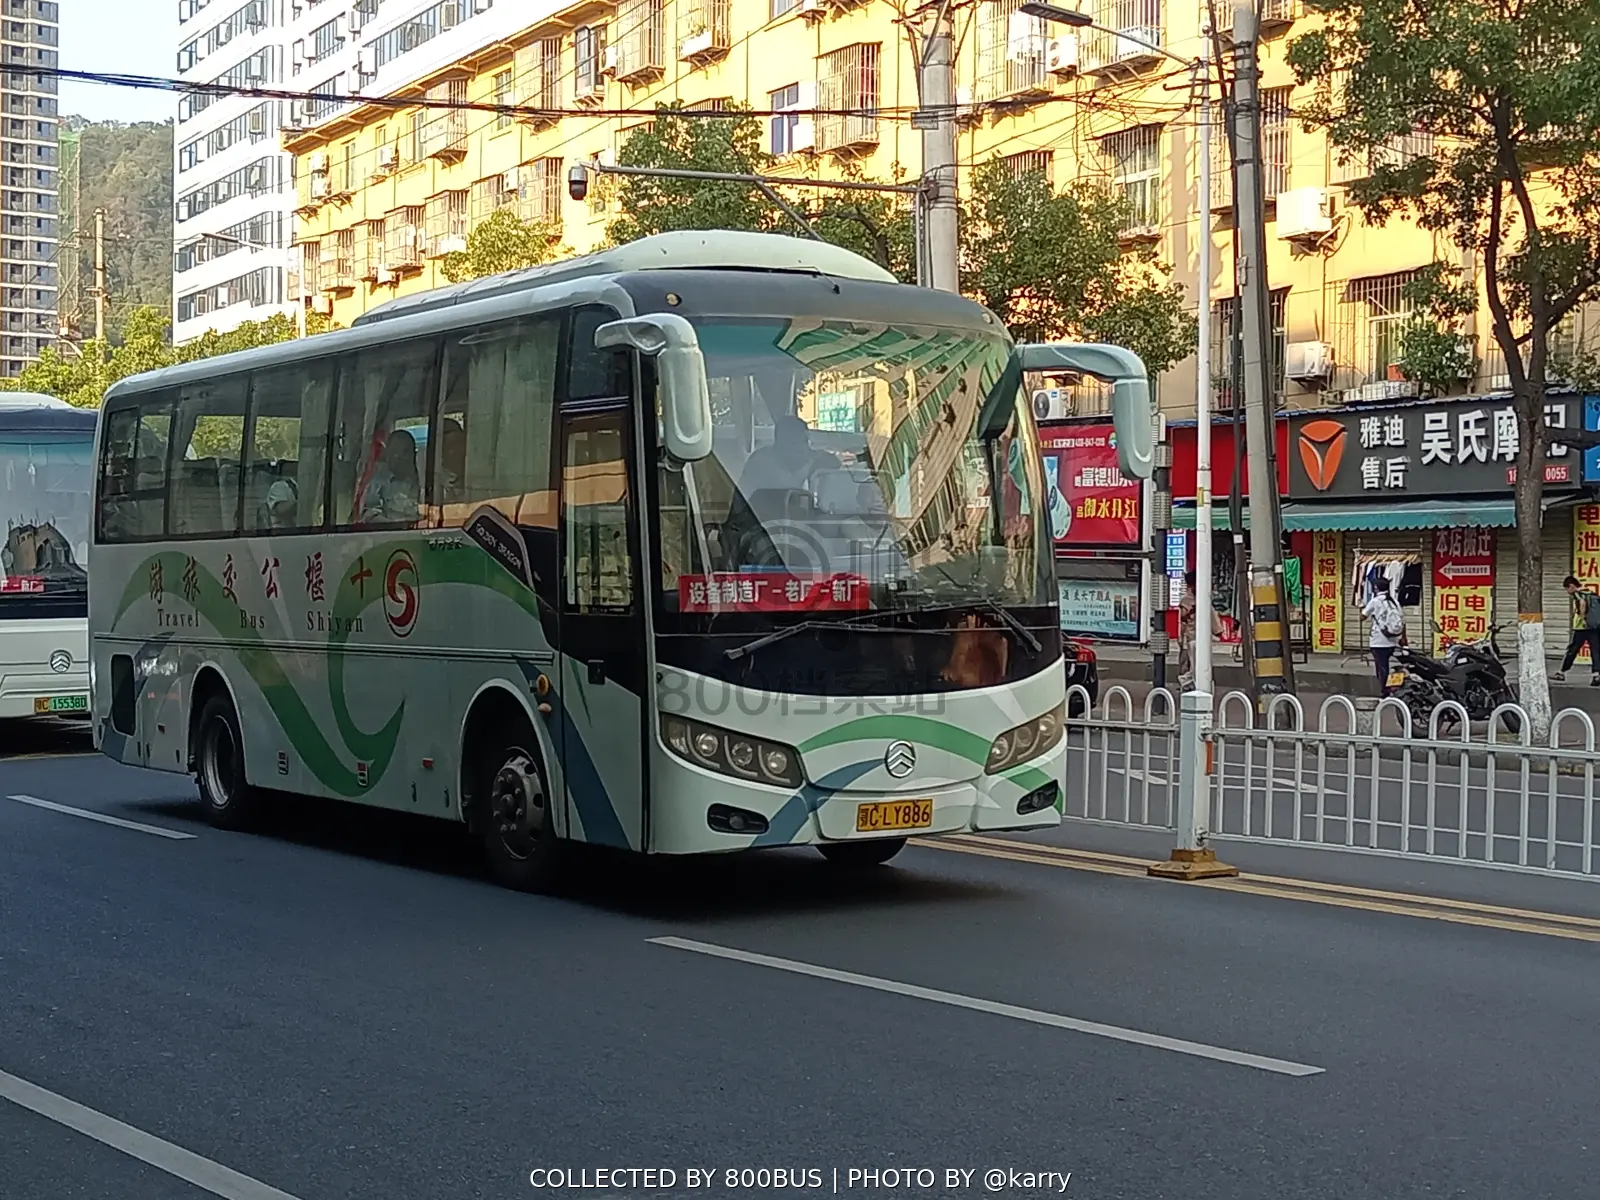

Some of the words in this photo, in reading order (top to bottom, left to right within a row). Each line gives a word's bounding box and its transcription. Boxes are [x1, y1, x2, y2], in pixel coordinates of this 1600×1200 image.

[1360, 414, 1405, 448] 雅迪
[1361, 456, 1406, 489] 售后
[1436, 528, 1491, 557] 本店搬迁
[157, 608, 200, 628] Travel
[240, 609, 266, 630] Bus
[306, 611, 364, 636] Shiyan
[1439, 586, 1460, 652] 旧换新
[1463, 586, 1486, 642] 电动
